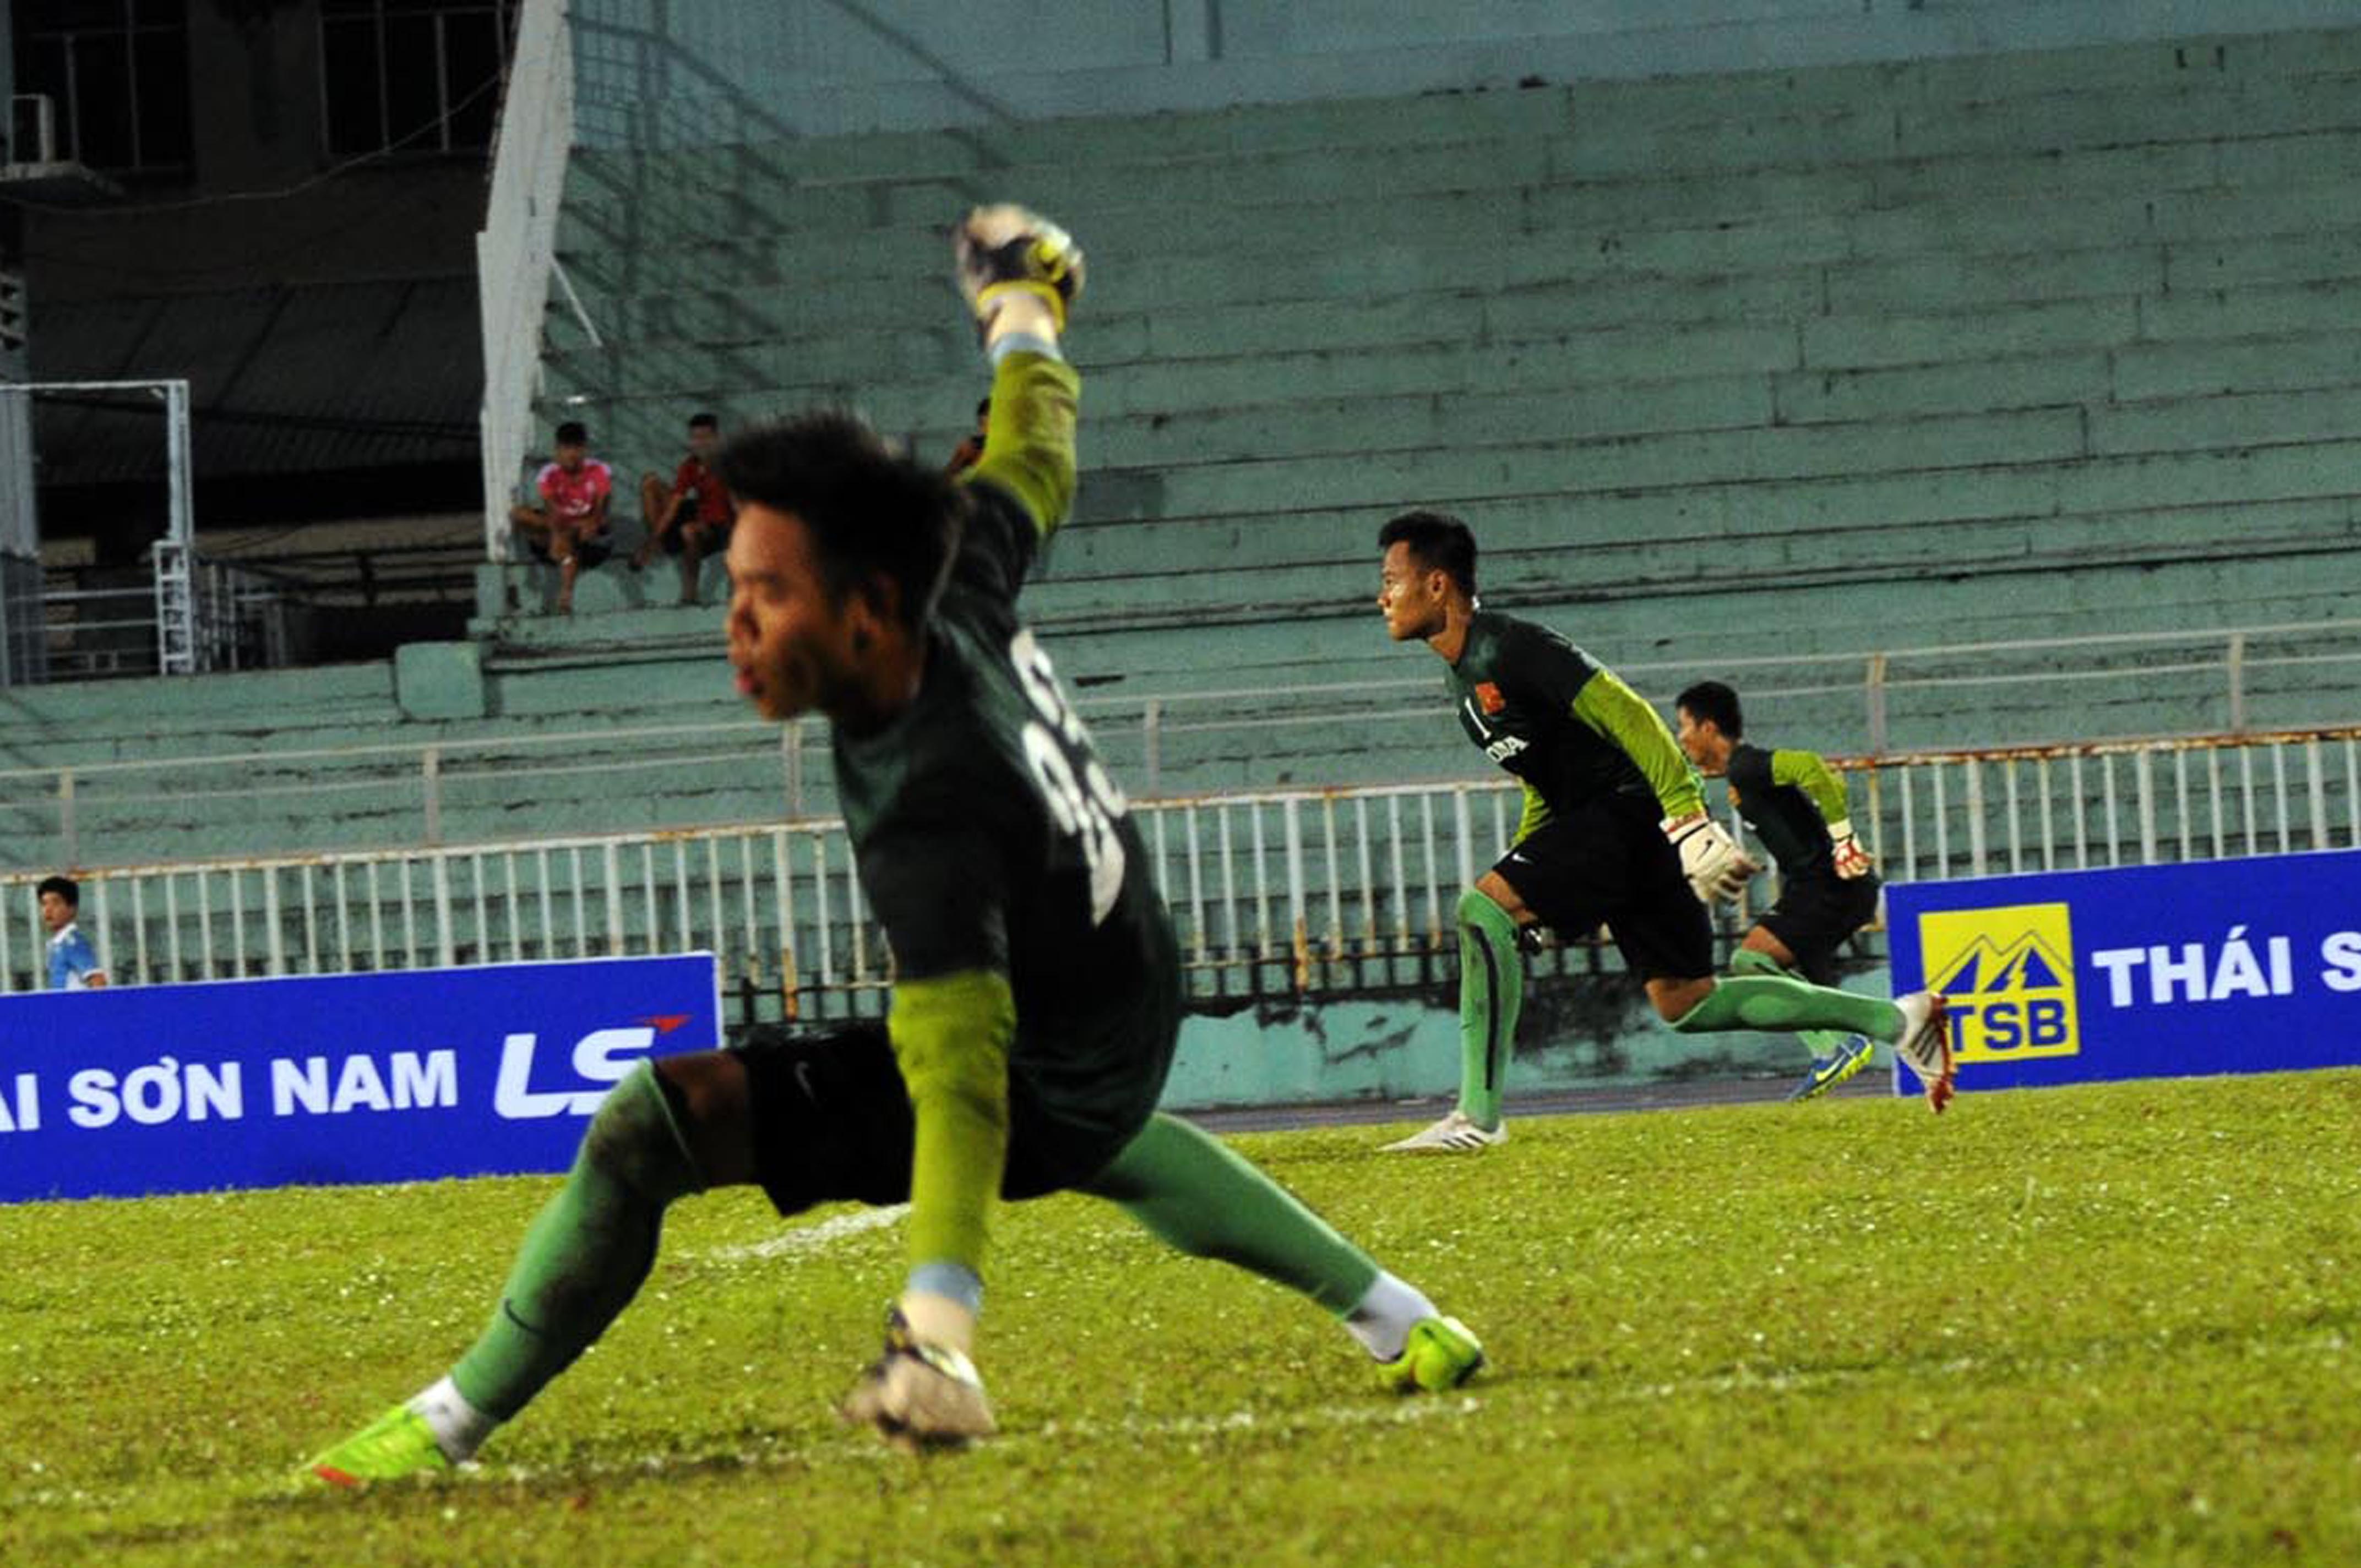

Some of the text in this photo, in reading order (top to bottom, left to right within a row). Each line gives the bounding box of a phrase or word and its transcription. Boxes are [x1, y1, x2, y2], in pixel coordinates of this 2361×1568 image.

[2092, 925, 2293, 1008] THÁI
[1940, 999, 2068, 1052] TSB
[68, 1056, 243, 1128] SƠN
[271, 1049, 458, 1116] NAM
[494, 1027, 655, 1119] LS
